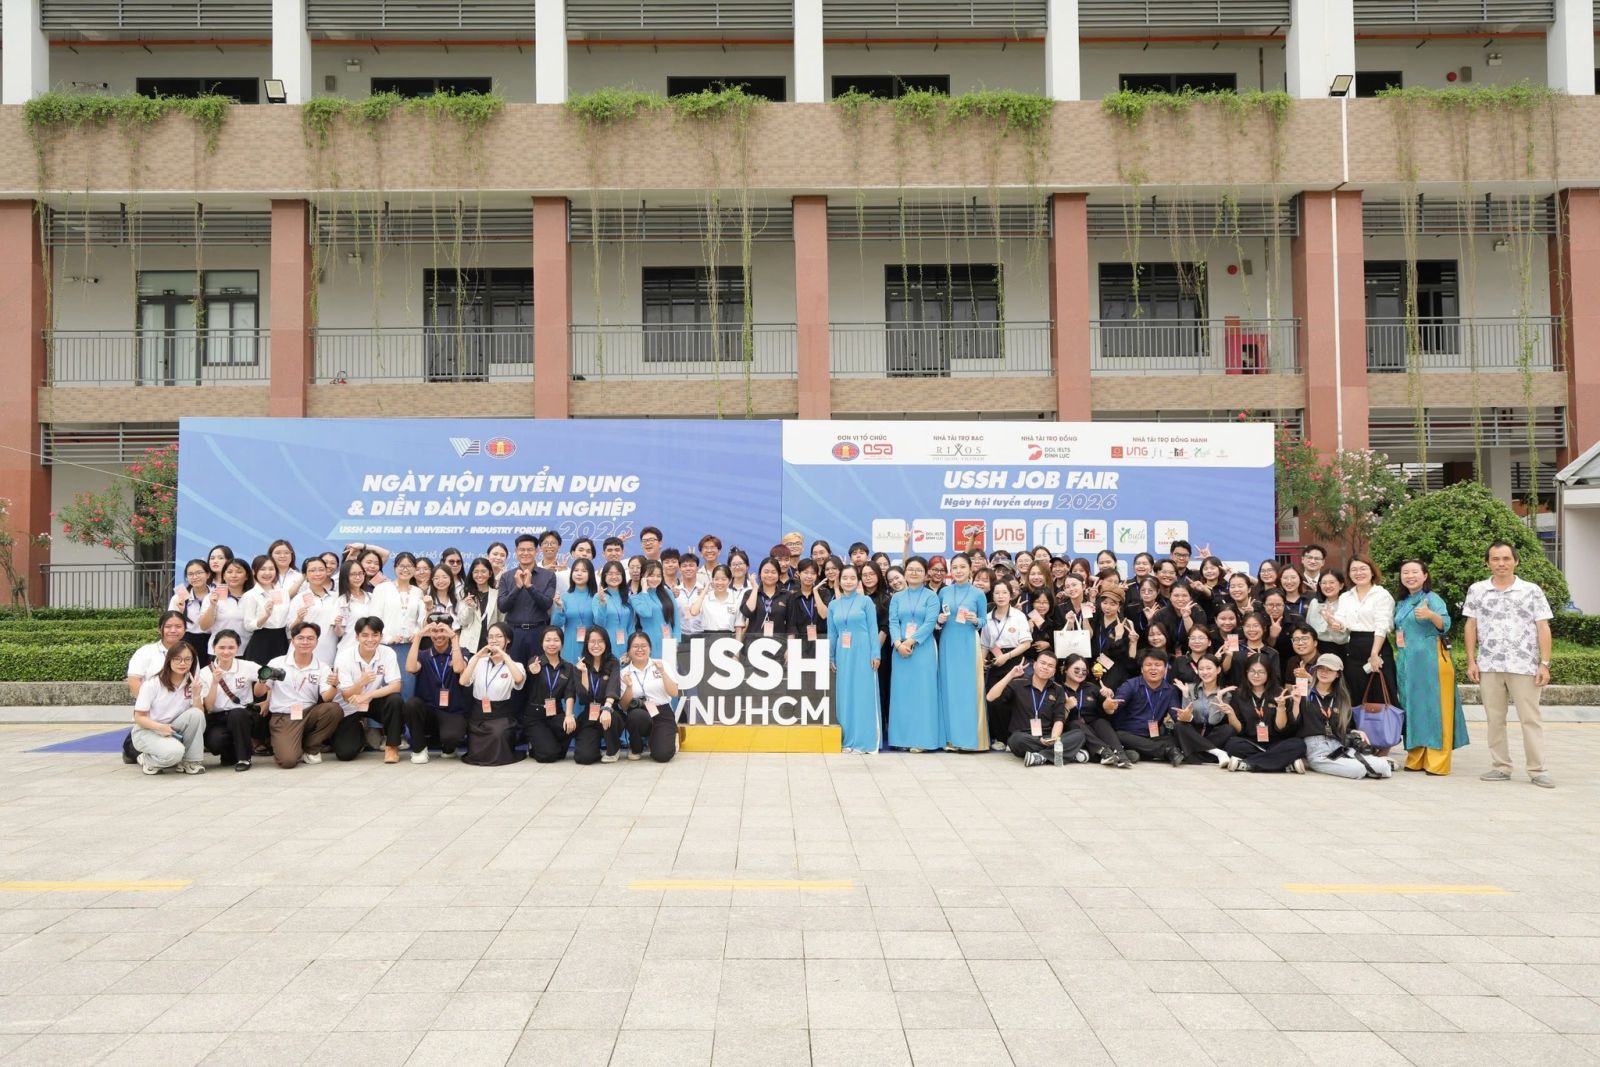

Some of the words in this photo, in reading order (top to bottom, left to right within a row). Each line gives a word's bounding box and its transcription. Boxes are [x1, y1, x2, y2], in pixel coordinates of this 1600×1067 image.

[362, 470, 435, 492] NGÀY
[438, 471, 484, 497] HỘI
[489, 466, 566, 493] TUYỂN
[569, 475, 640, 498] DỤNG
[944, 470, 1009, 489] USSH
[1012, 470, 1060, 489] JOB
[1065, 471, 1120, 490] FAIR
[347, 499, 365, 516] &
[370, 494, 421, 516] DIỄN
[424, 496, 471, 516] ĐÀN
[475, 500, 553, 516] DOANH
[556, 498, 637, 521] NGHIỆP
[944, 497, 972, 508] Ngày
[1055, 493, 1118, 511] 2026
[339, 525, 363, 534] USSH
[364, 525, 382, 534] JOB
[383, 525, 403, 534] FAIR
[414, 526, 466, 535] UNIVERSITY
[470, 526, 513, 535] INDUSTRY
[514, 526, 548, 535] FORUM
[994, 528, 1025, 542] VNG
[662, 637, 830, 690] USSH
